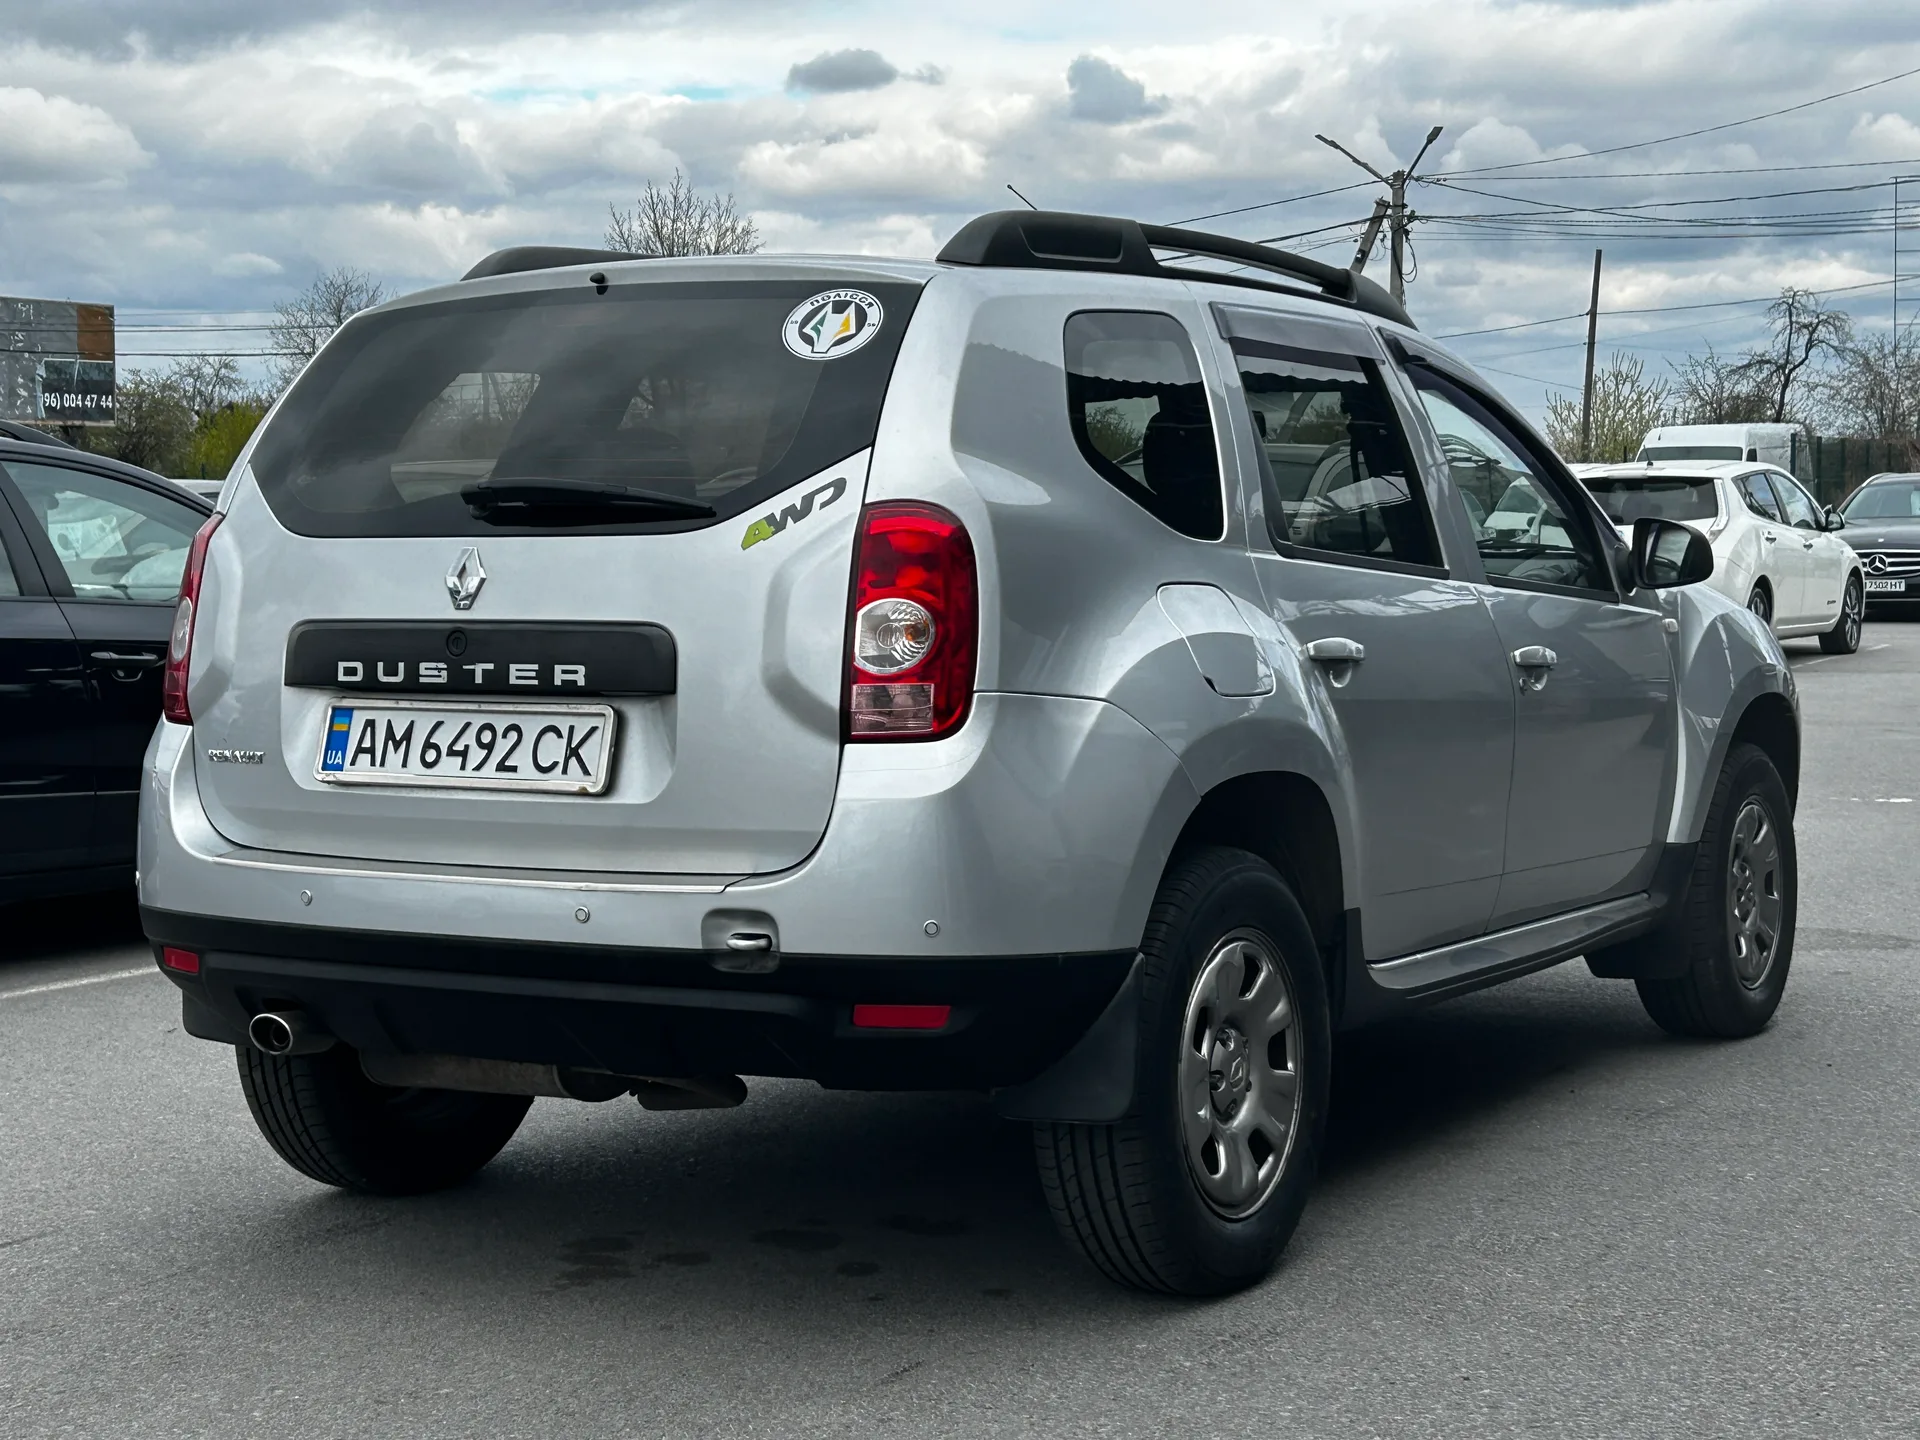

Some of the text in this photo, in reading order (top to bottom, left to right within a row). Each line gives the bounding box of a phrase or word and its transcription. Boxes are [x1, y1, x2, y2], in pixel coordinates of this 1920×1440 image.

[63, 393, 82, 408] 004
[85, 394, 98, 409] 47
[100, 395, 113, 409] 44
[741, 477, 847, 551] 4WD
[337, 661, 586, 686] DUSTER
[327, 750, 343, 765] UA
